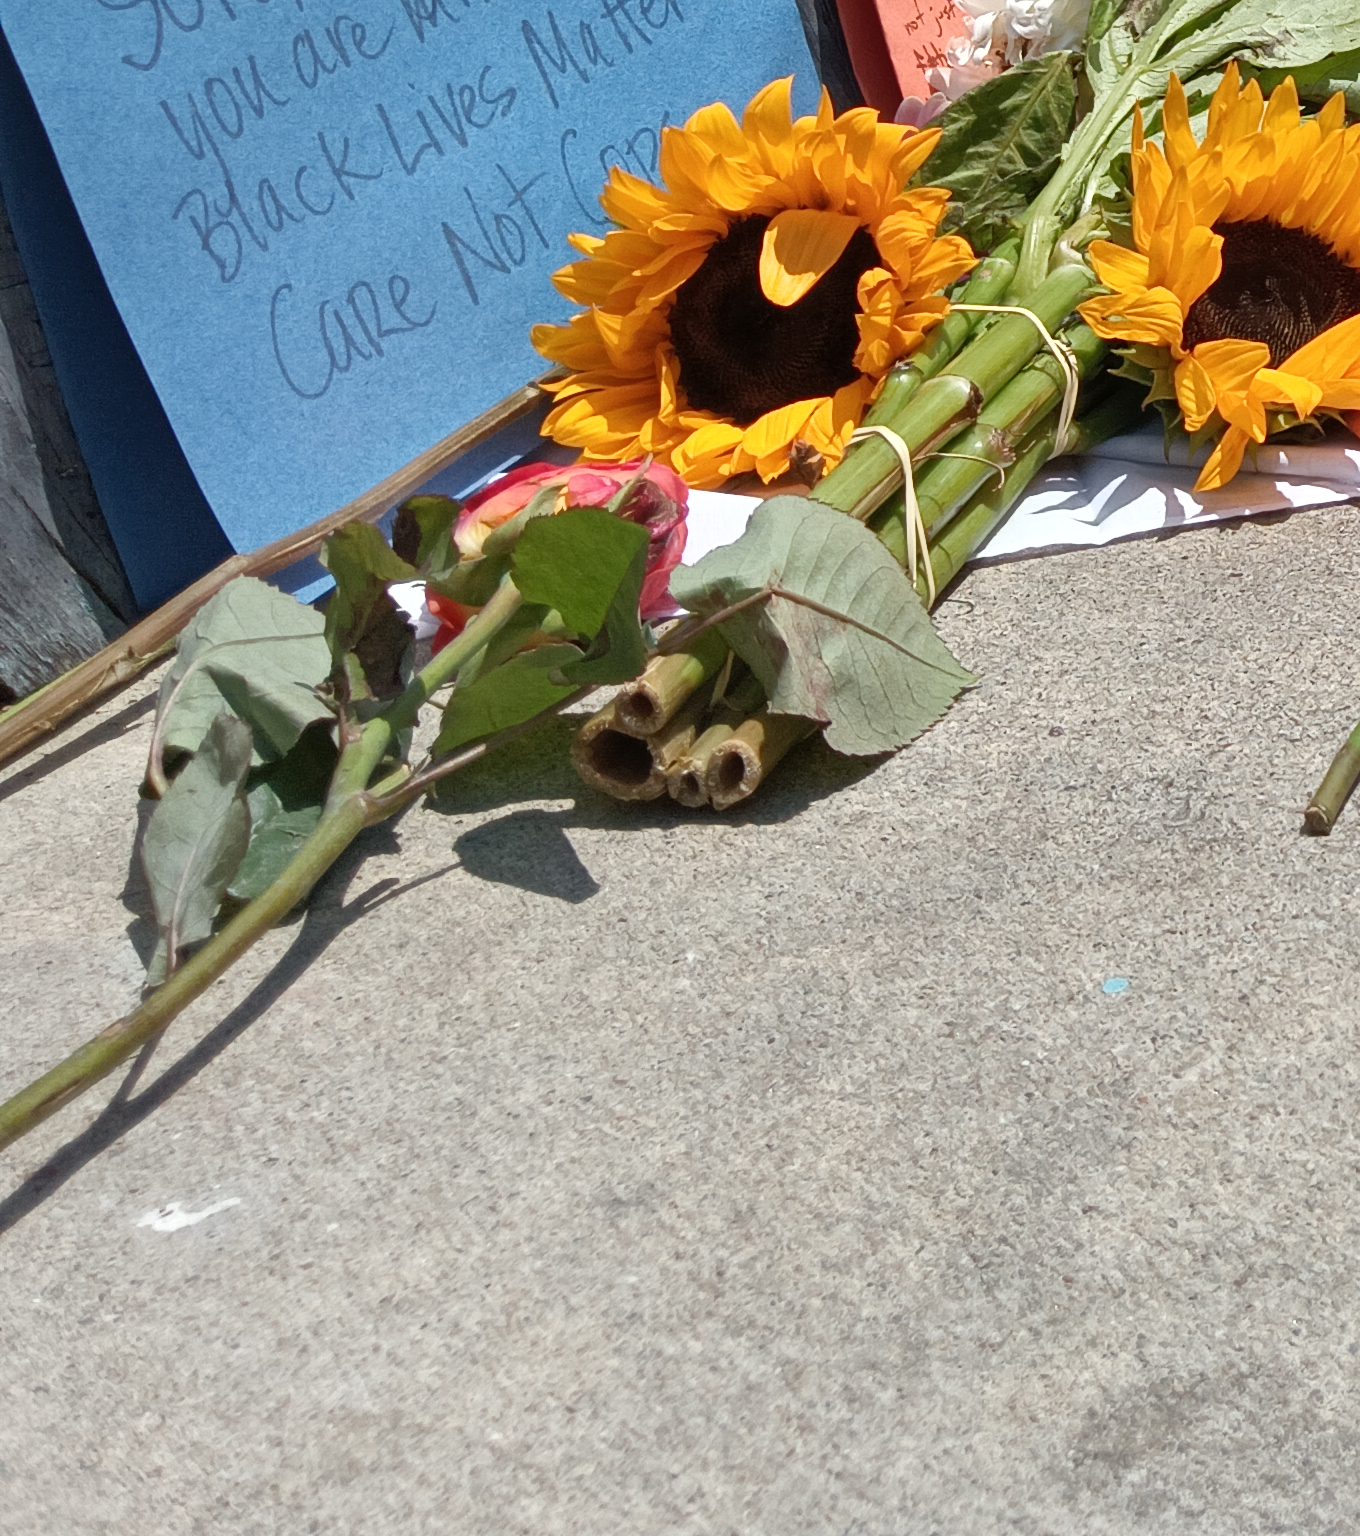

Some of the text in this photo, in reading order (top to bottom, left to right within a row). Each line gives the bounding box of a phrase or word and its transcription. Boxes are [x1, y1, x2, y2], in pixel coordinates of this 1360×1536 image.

[160, 65, 288, 165] you
[291, 14, 391, 96] are
[173, 124, 385, 285] Black
[376, 79, 519, 176] Lives
[440, 162, 551, 308] Not
[560, 109, 671, 226] Cop
